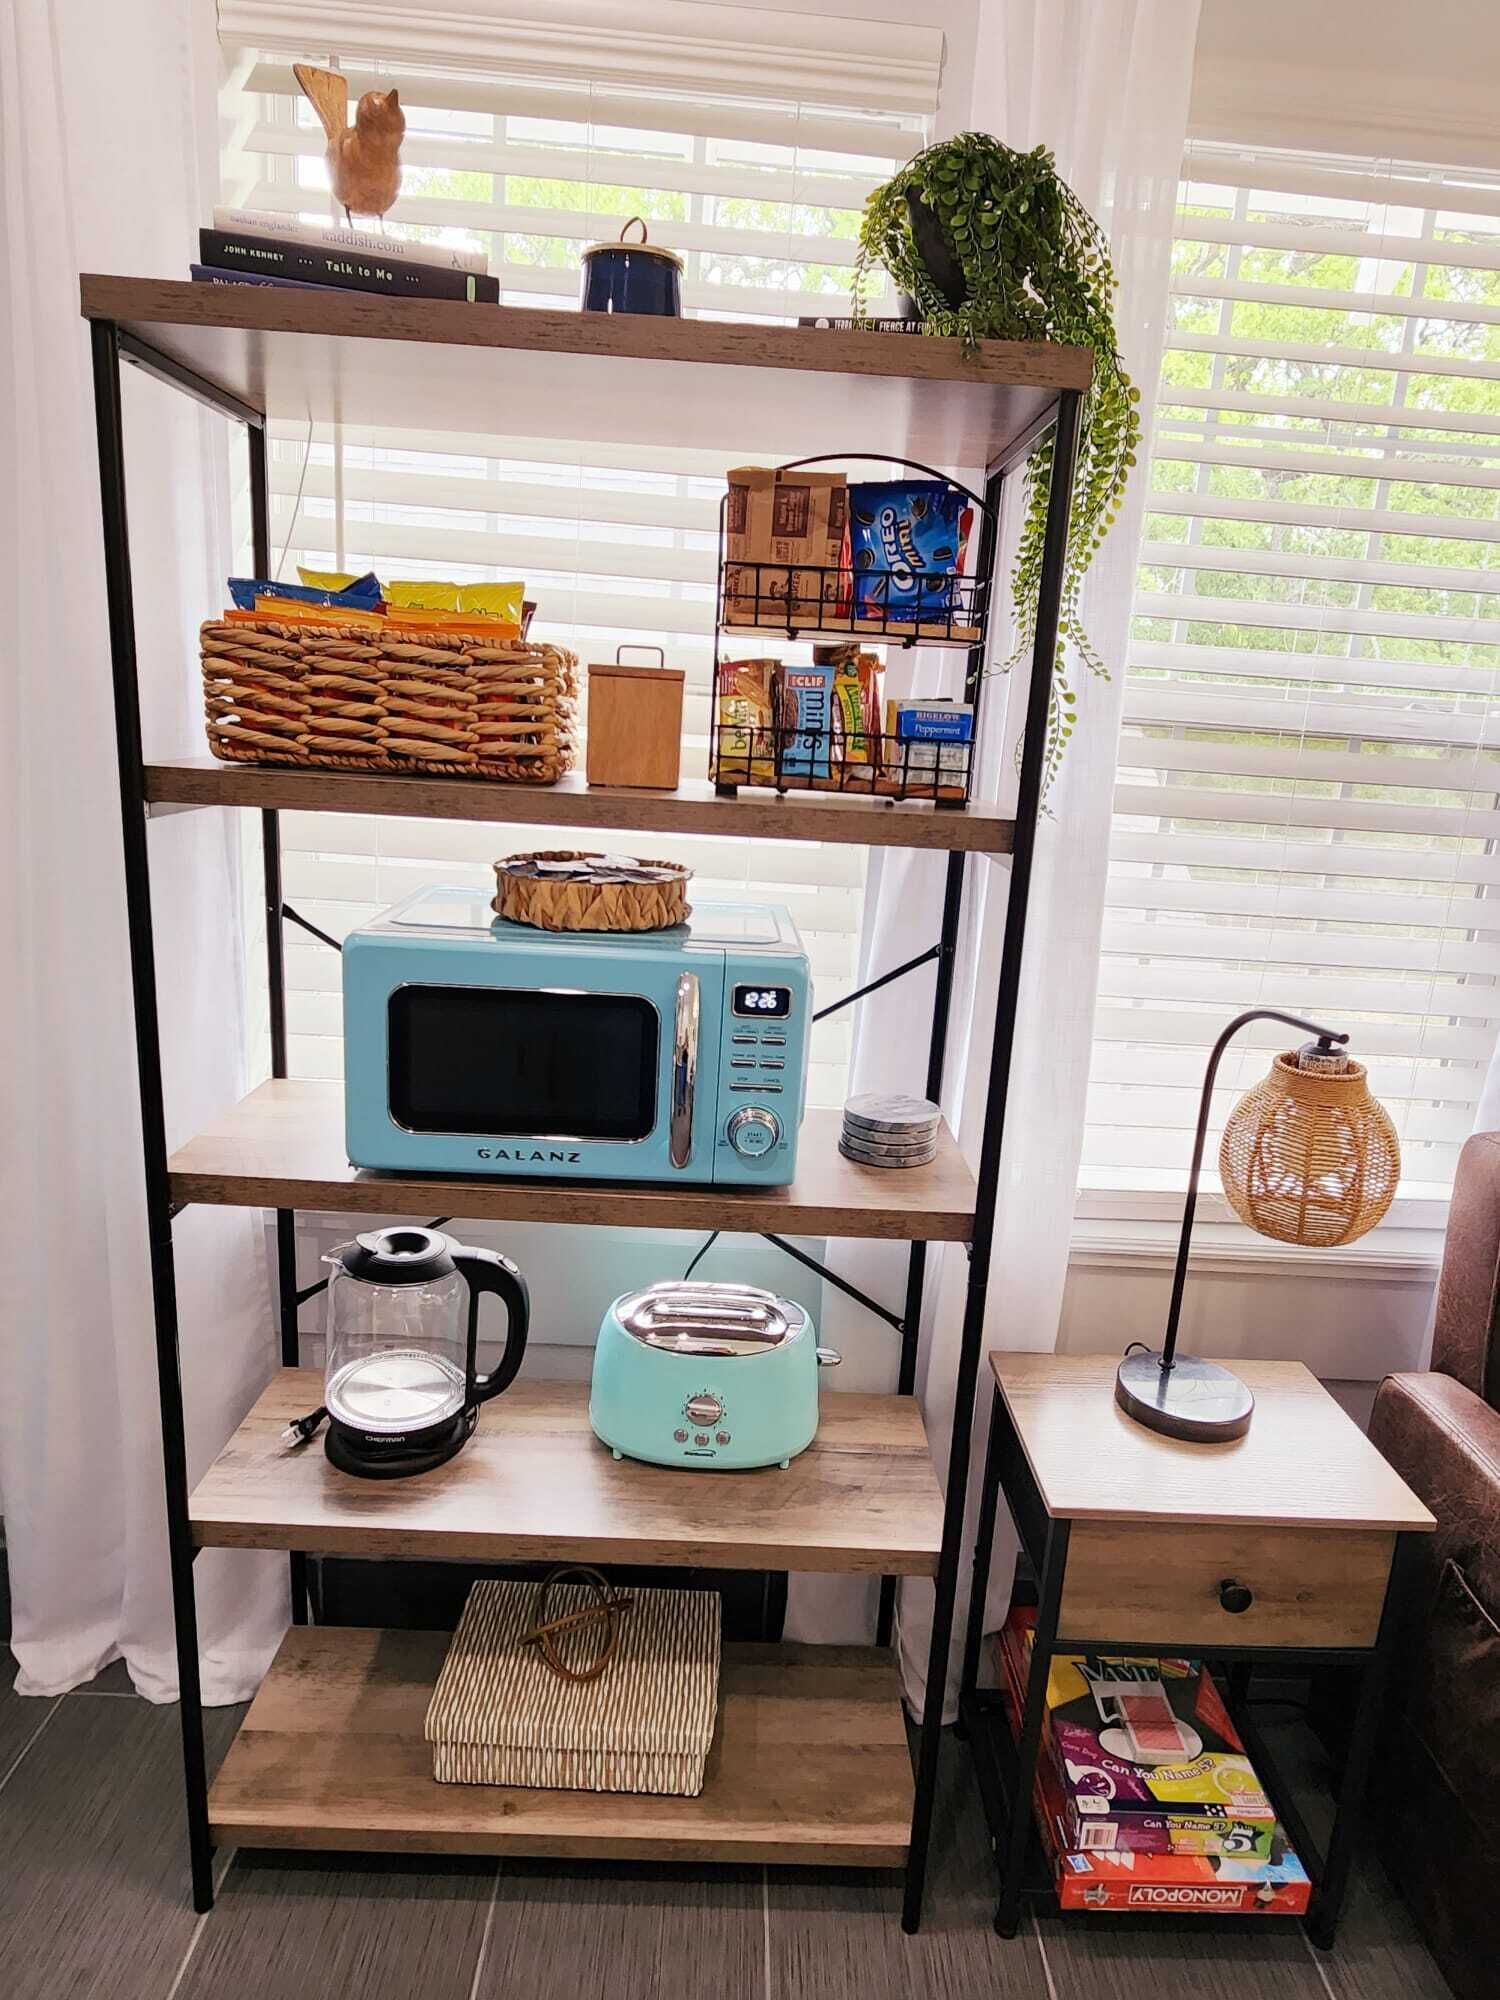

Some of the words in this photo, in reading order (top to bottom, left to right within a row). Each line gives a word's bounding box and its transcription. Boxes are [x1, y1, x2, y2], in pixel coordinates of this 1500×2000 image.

[223, 245, 247, 256] JOHN
[250, 249, 284, 262] KENNEY
[325, 260, 353, 274] Talk
[358, 266, 371, 277] to
[376, 269, 393, 281] Me
[880, 506, 914, 591] OREO
[897, 519, 926, 569] mini
[791, 572, 802, 611] QAKER
[796, 676, 824, 687] CLIF
[915, 711, 960, 721] BIGELOW
[914, 723, 961, 738] Peppermint
[477, 1148, 581, 1163] GALANZ
[1101, 1759, 1130, 1778] Can
[1133, 1767, 1159, 1782] You
[1162, 1769, 1201, 1782] Name
[1143, 1820, 1162, 1829] Can
[1165, 1820, 1183, 1829] You
[1184, 1821, 1212, 1831] Name
[1131, 1887, 1240, 1902] MONOPOLY
